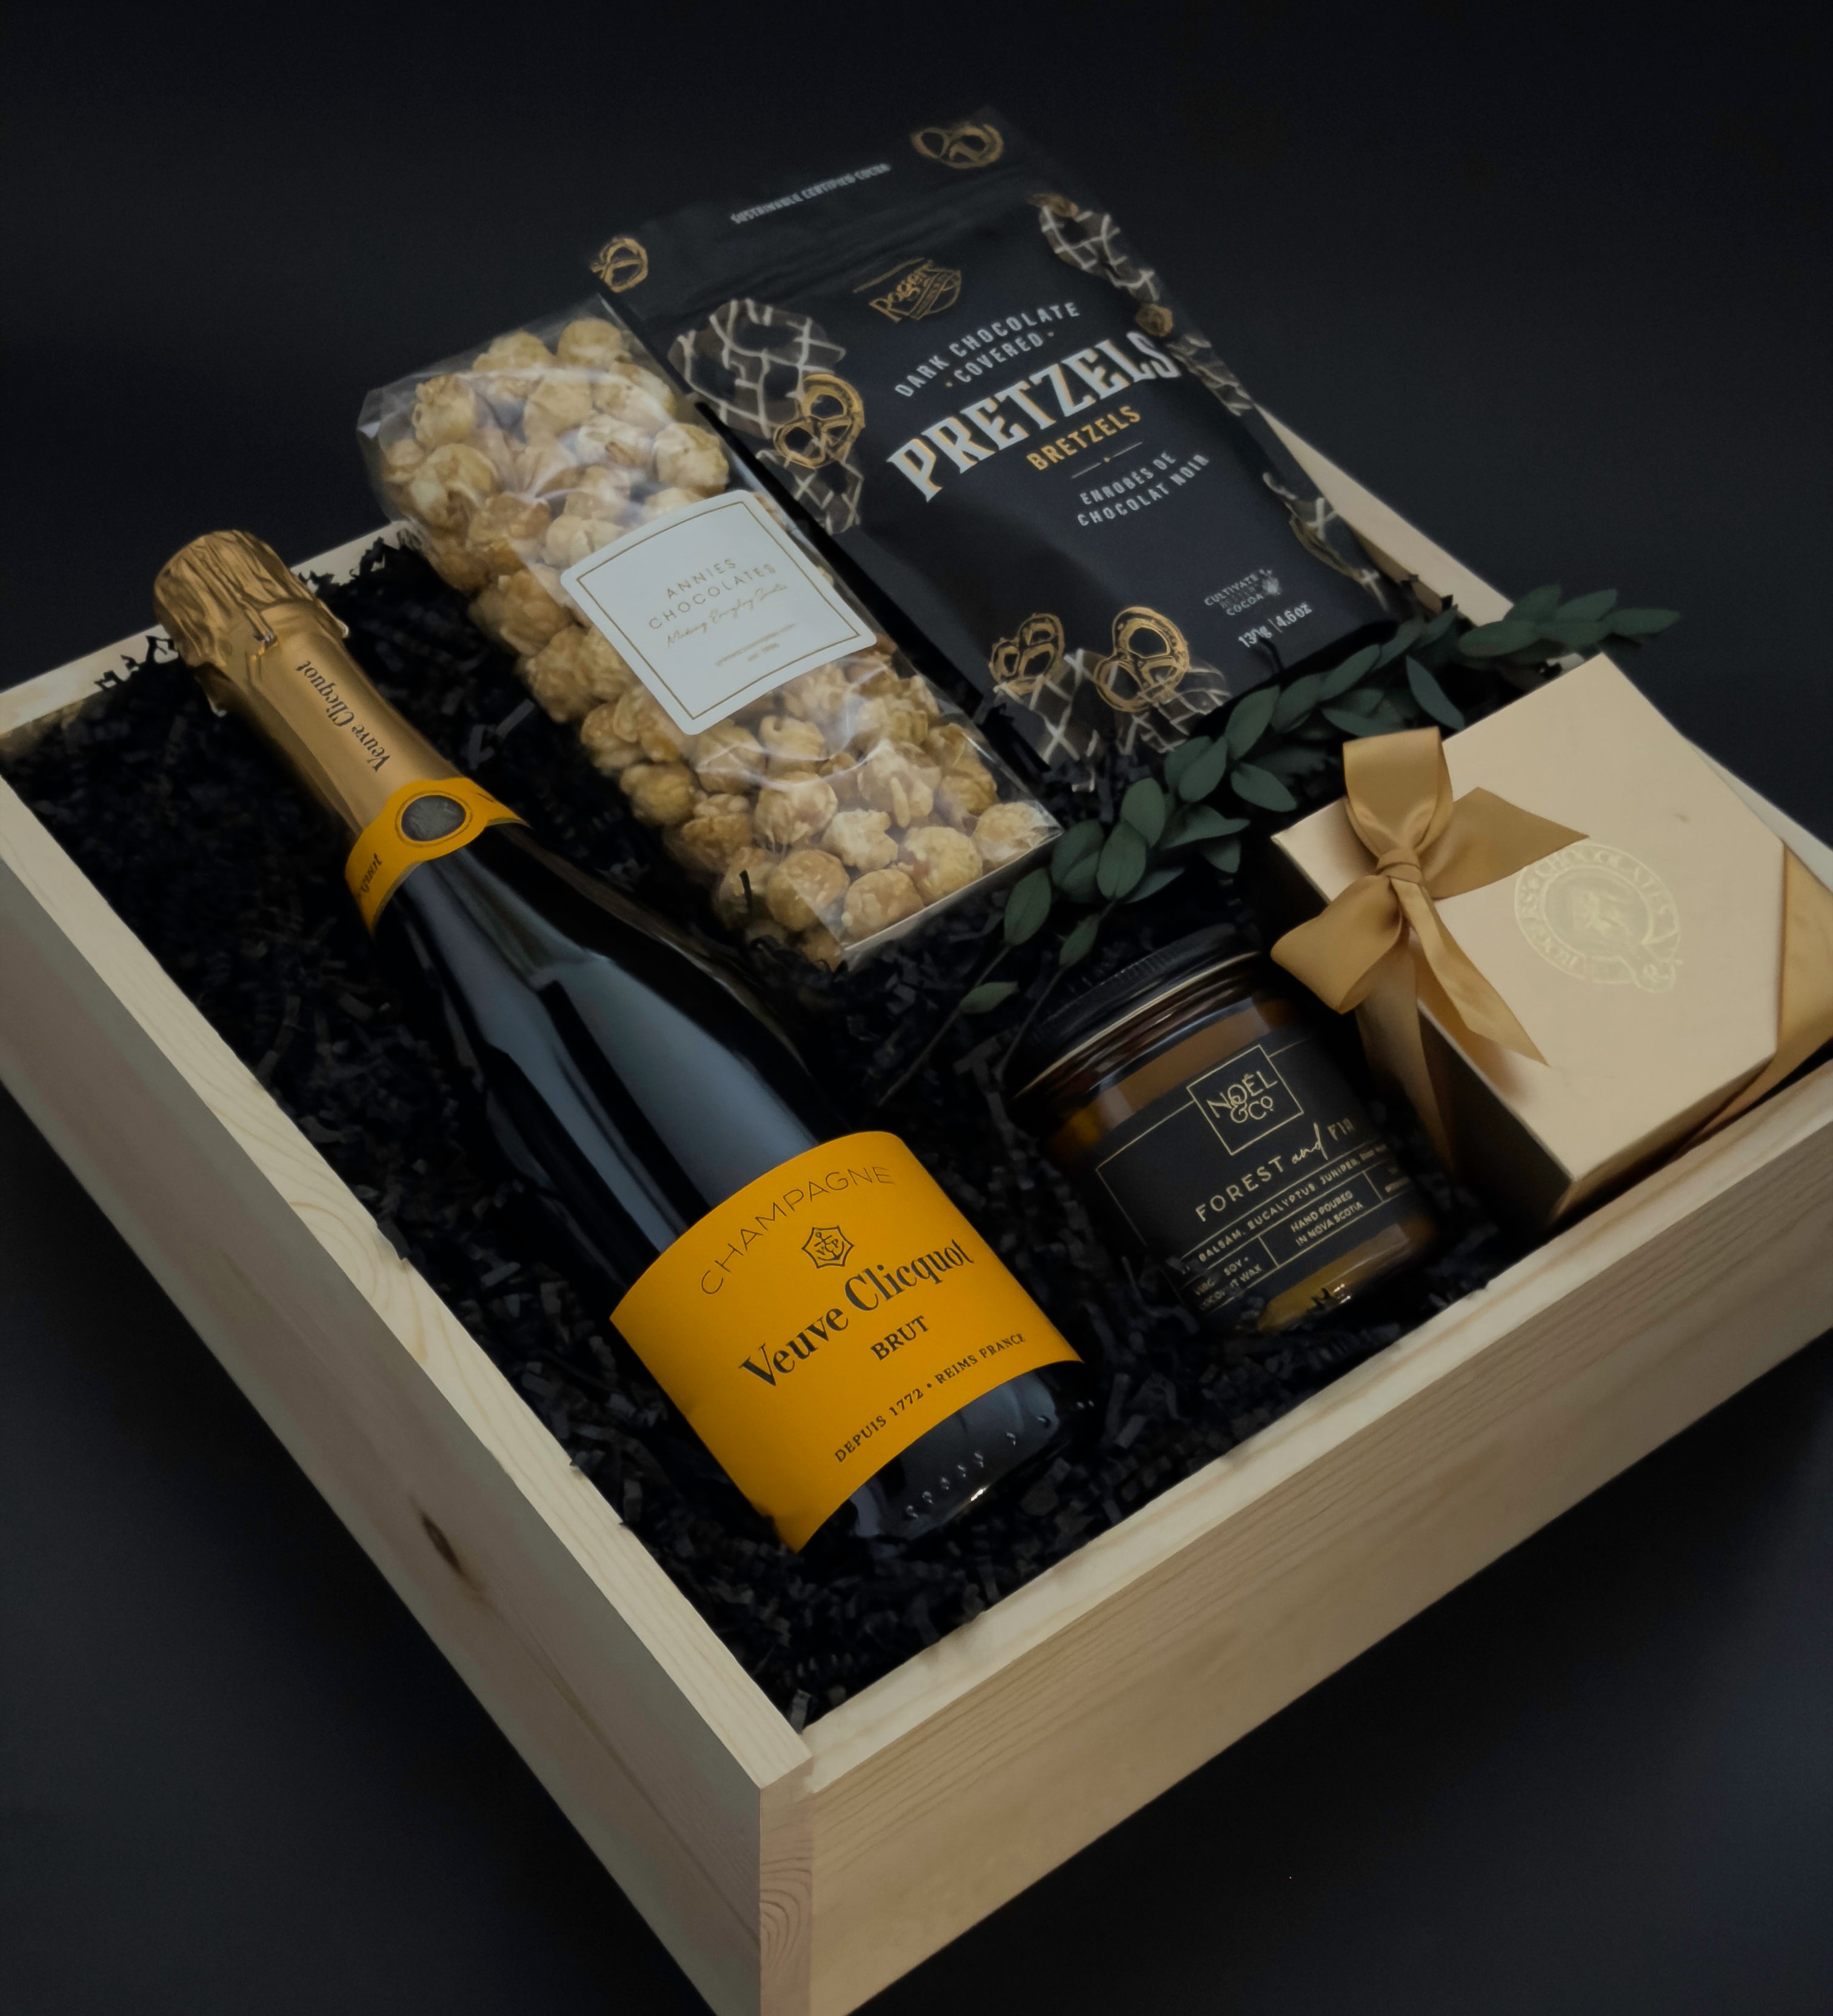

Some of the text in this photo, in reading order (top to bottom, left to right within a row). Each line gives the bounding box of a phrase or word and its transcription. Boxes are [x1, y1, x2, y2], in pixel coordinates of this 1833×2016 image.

[894, 301, 1080, 397] DARK CHOCOLATE
[953, 332, 1044, 382] COVERED
[886, 330, 1182, 502] PRETZELS
[1026, 406, 1141, 471] BRETZELS
[1077, 453, 1210, 526] CHOCOLAT NOIR
[1153, 450, 1176, 470] DE
[649, 564, 776, 629] CHOCOLATES
[667, 559, 736, 599] ANNIES
[1204, 574, 1259, 606] CULTIVATE
[1226, 594, 1264, 616] COCOA
[296, 660, 391, 772] Veuve Clicquot
[1195, 1155, 1285, 1223] FOREST
[1290, 1123, 1329, 1165] and
[701, 1166, 895, 1295] CHAMPAGNE
[1290, 1190, 1354, 1233] HAND POURED
[1295, 1201, 1364, 1246] IN NOVA SCOTIA
[1239, 1264, 1264, 1285] WAX
[738, 1238, 974, 1387] Veuve Clicquot
[870, 1315, 929, 1361] BRUT
[834, 1333, 1025, 1463] DEPUIS 1772 REIMS FRANCE
